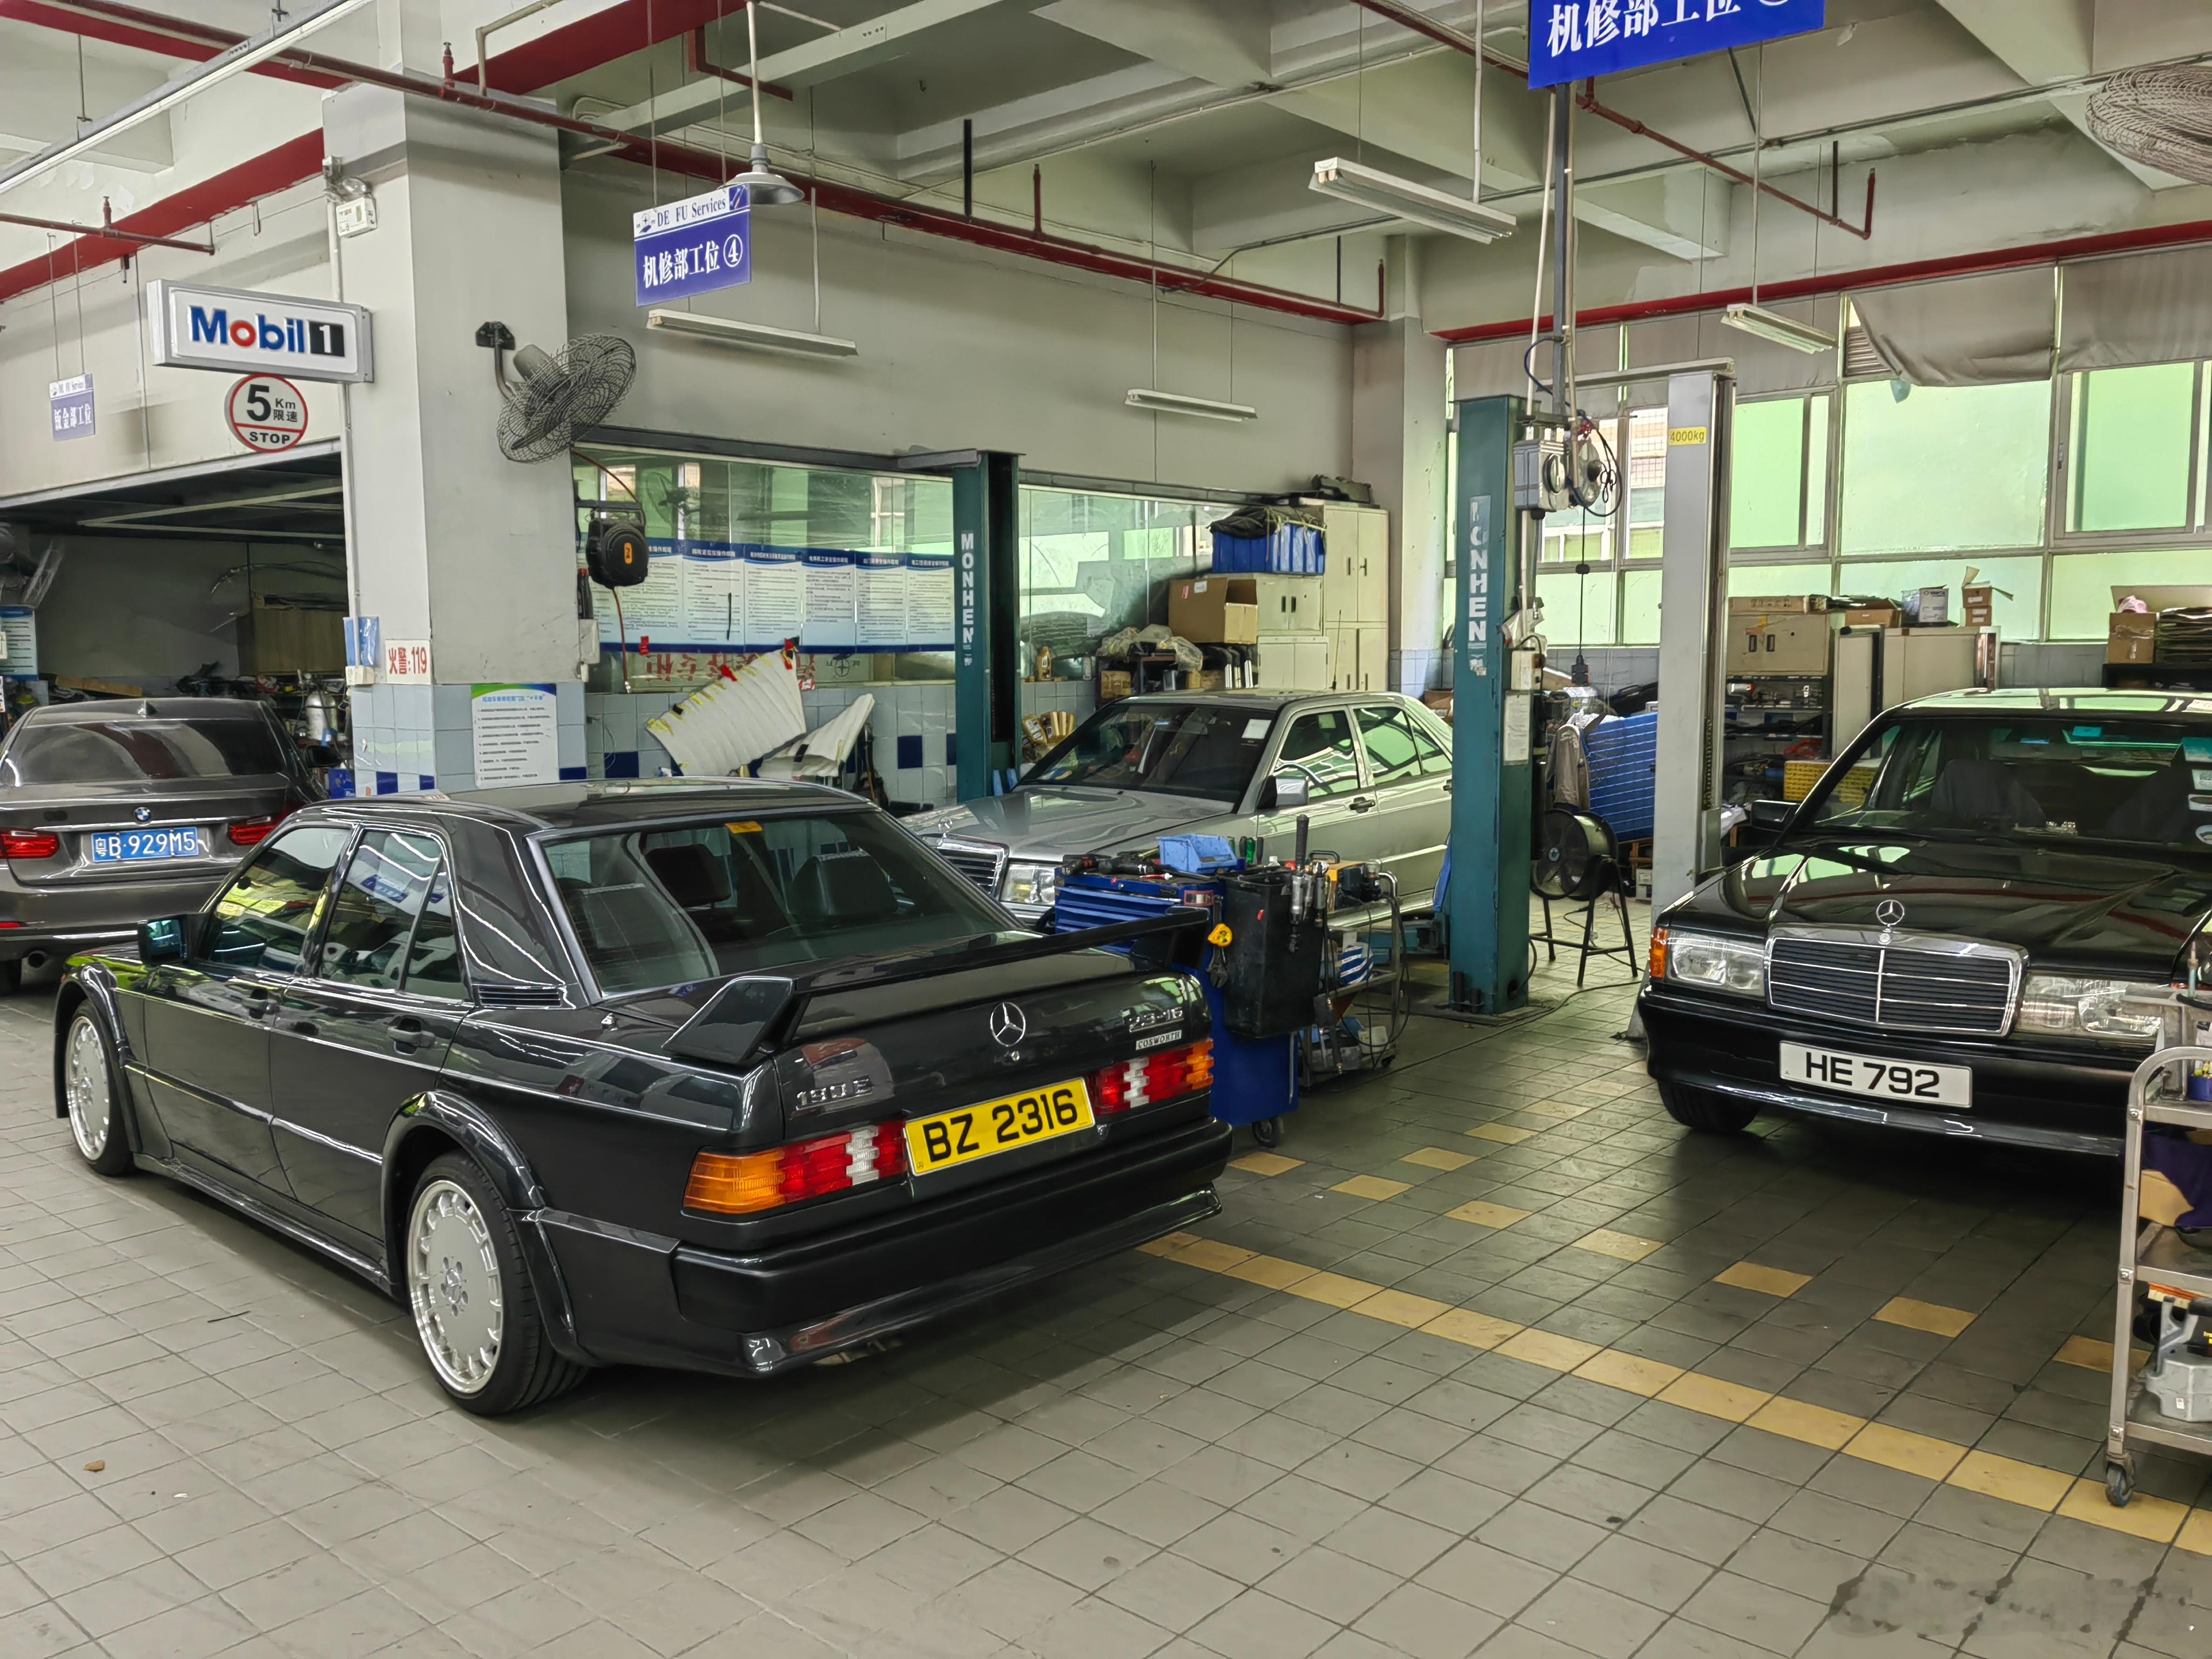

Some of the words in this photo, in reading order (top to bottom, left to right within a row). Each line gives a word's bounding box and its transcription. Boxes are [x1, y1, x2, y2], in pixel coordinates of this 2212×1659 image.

[676, 205, 688, 222] FU
[691, 197, 726, 218] Services
[190, 306, 305, 353] Mobil
[246, 384, 271, 421] 5
[275, 398, 296, 410] Km
[273, 409, 298, 422] 限速
[249, 431, 290, 444] STOP
[1670, 430, 1704, 443] 4000kg
[961, 533, 974, 644] MONHEN
[1138, 1031, 1180, 1049] COSWORTH
[1806, 1051, 1853, 1087] HE
[1863, 1062, 1940, 1098] 792
[922, 1113, 980, 1163] BZ
[992, 1089, 1078, 1144] 2316
